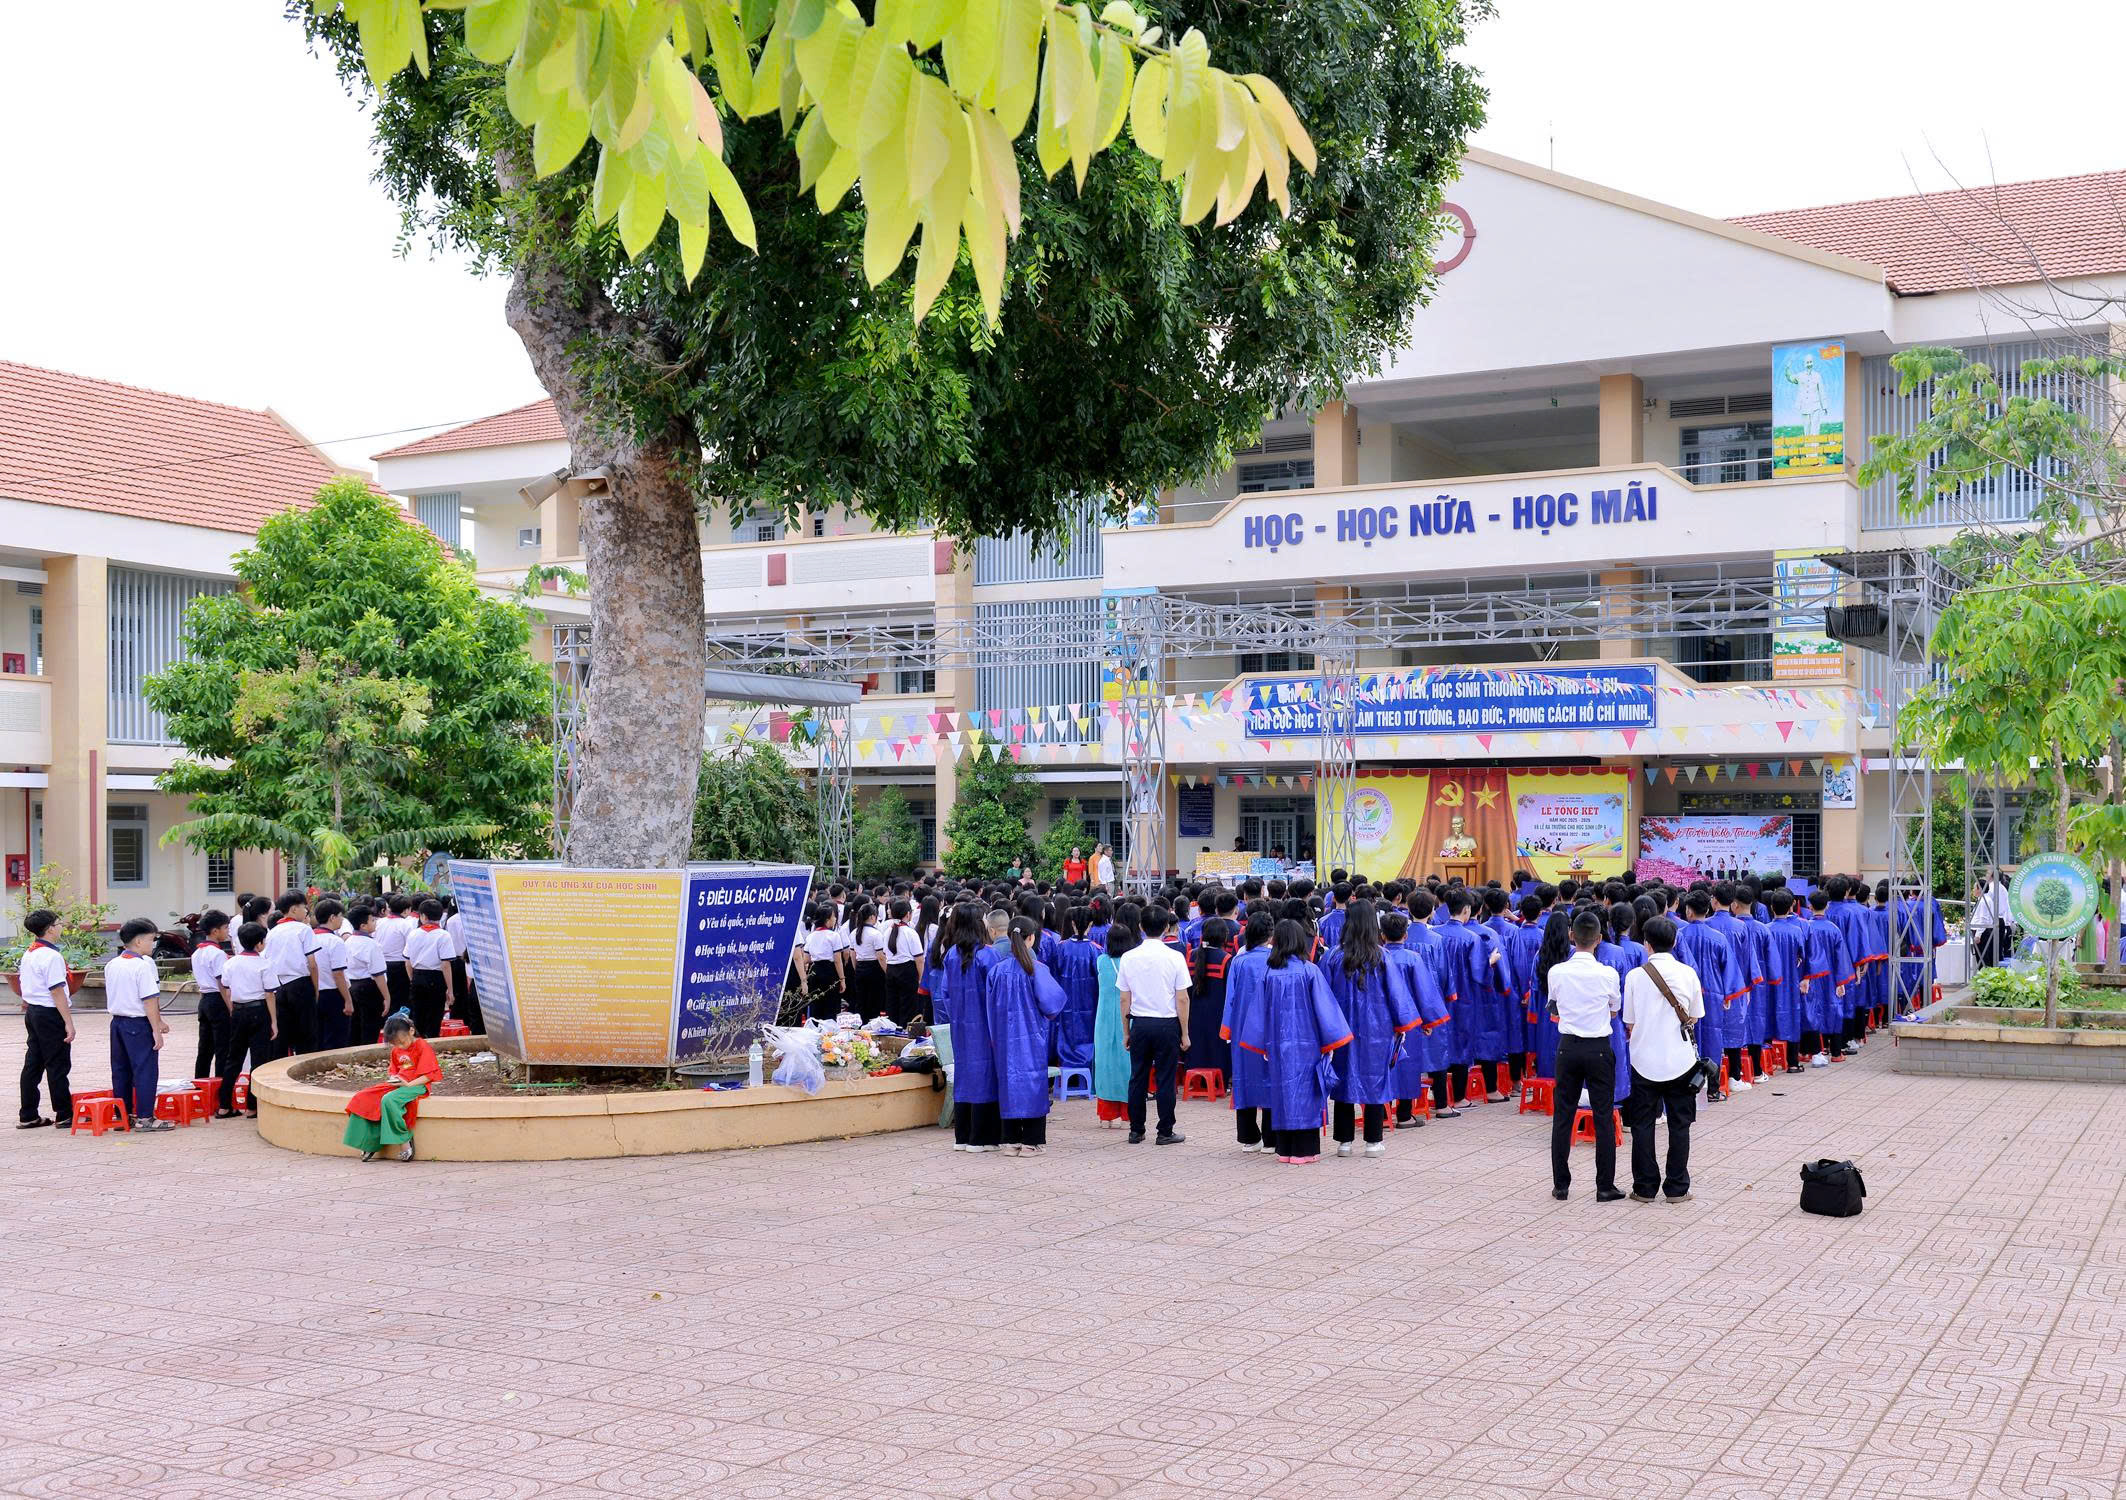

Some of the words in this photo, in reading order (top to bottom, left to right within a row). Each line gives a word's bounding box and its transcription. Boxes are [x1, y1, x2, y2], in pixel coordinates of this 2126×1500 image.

[1244, 513, 1304, 553] HỌC
[1337, 505, 1398, 548] HỌC
[1409, 494, 1476, 537] NỮA
[1512, 492, 1578, 536] HỌC
[1591, 480, 1657, 525] MÃI
[1431, 681, 1453, 703] HỌC
[1455, 681, 1481, 699] SINH
[1294, 712, 1314, 733] HỌC
[1376, 710, 1402, 727] THEO
[1403, 708, 1418, 727] TƯ
[1418, 704, 1456, 728] TƯỞNG,
[1458, 708, 1480, 729] ĐẠO
[1481, 704, 1506, 727] ĐỨC,
[1508, 706, 1545, 725] PHONG
[1547, 703, 1577, 723] CÁCH
[1579, 700, 1594, 722] HỒ
[1597, 701, 1615, 722] CHÍ
[1618, 703, 1652, 721] MINH.
[1554, 802, 1580, 816] TỔNG
[1581, 803, 1600, 816] KẾT
[522, 880, 539, 889] QUY
[636, 882, 657, 891] SINH
[697, 890, 706, 907] 5
[706, 886, 733, 906] ĐIỀU
[734, 885, 757, 905] BÁC
[758, 884, 774, 903] HỒ
[775, 886, 798, 905] DẠY
[706, 916, 719, 929] Yêu
[744, 914, 757, 929] yêu
[773, 912, 785, 924] bào
[701, 944, 715, 958] Học
[696, 971, 714, 983] Đoàn
